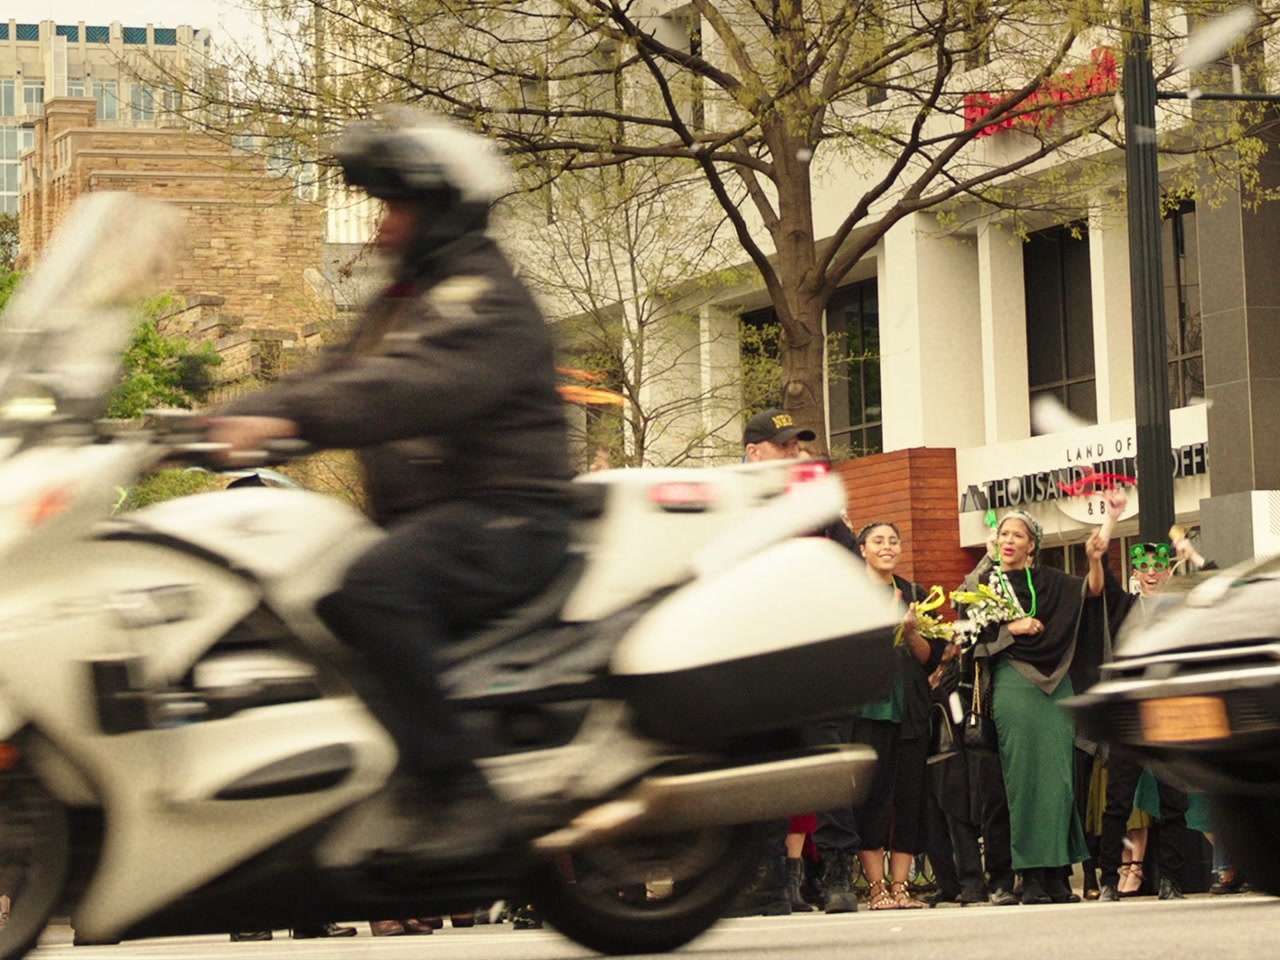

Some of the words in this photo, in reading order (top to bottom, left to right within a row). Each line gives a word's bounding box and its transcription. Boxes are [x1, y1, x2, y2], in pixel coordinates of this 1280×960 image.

[1066, 443, 1105, 462] LAND
[1115, 437, 1132, 453] OF
[983, 466, 1086, 508] THOUSAND
[1093, 456, 1138, 491] HILL
